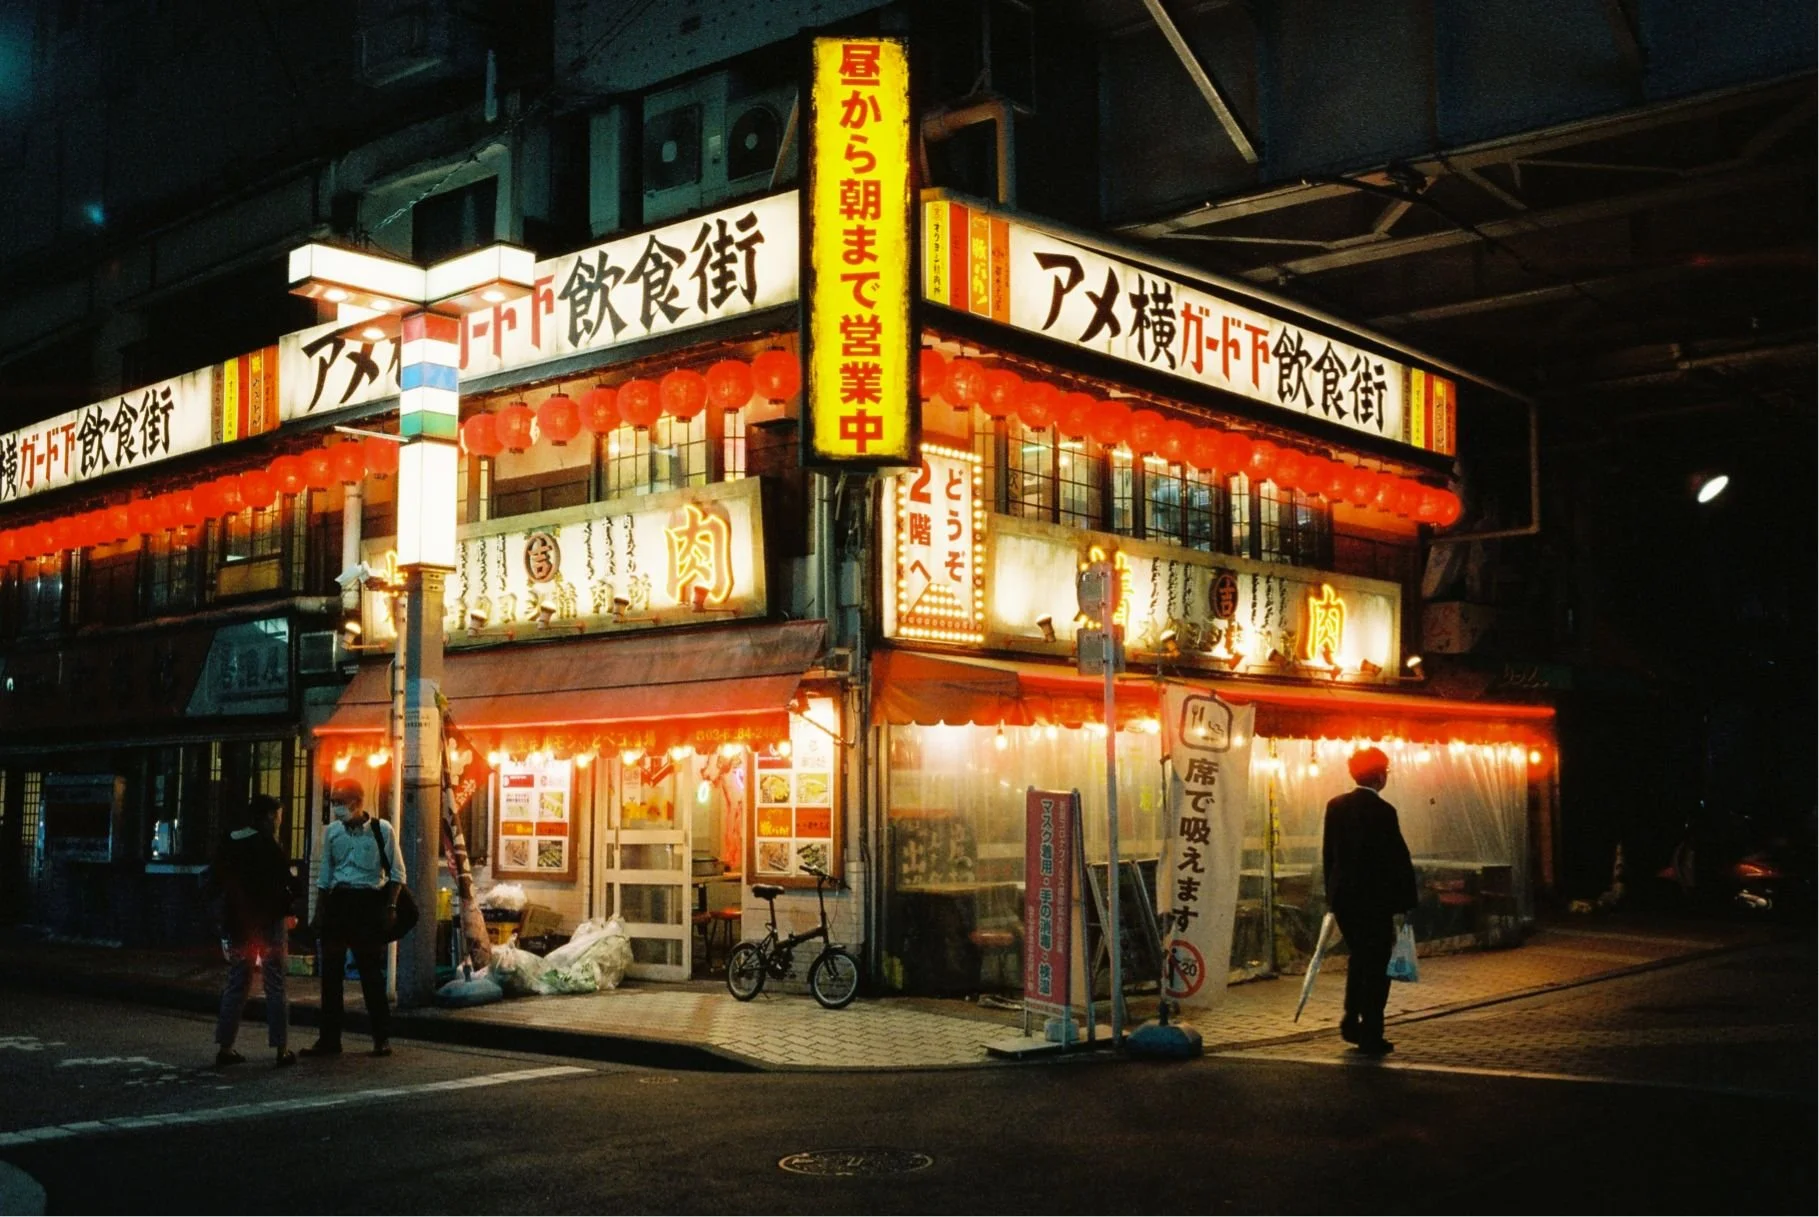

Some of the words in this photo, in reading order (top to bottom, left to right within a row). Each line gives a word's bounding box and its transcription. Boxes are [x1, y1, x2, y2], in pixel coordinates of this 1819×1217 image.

[839, 43, 883, 453] 昼から朝まで営業中
[1033, 251, 1388, 433] アメ横ガード下飲食街
[663, 504, 733, 604] 肉
[944, 468, 965, 583] どうぞ
[1307, 583, 1347, 660] 肉
[1172, 758, 1219, 933] 席で吸えます
[1181, 962, 1197, 977] 20
